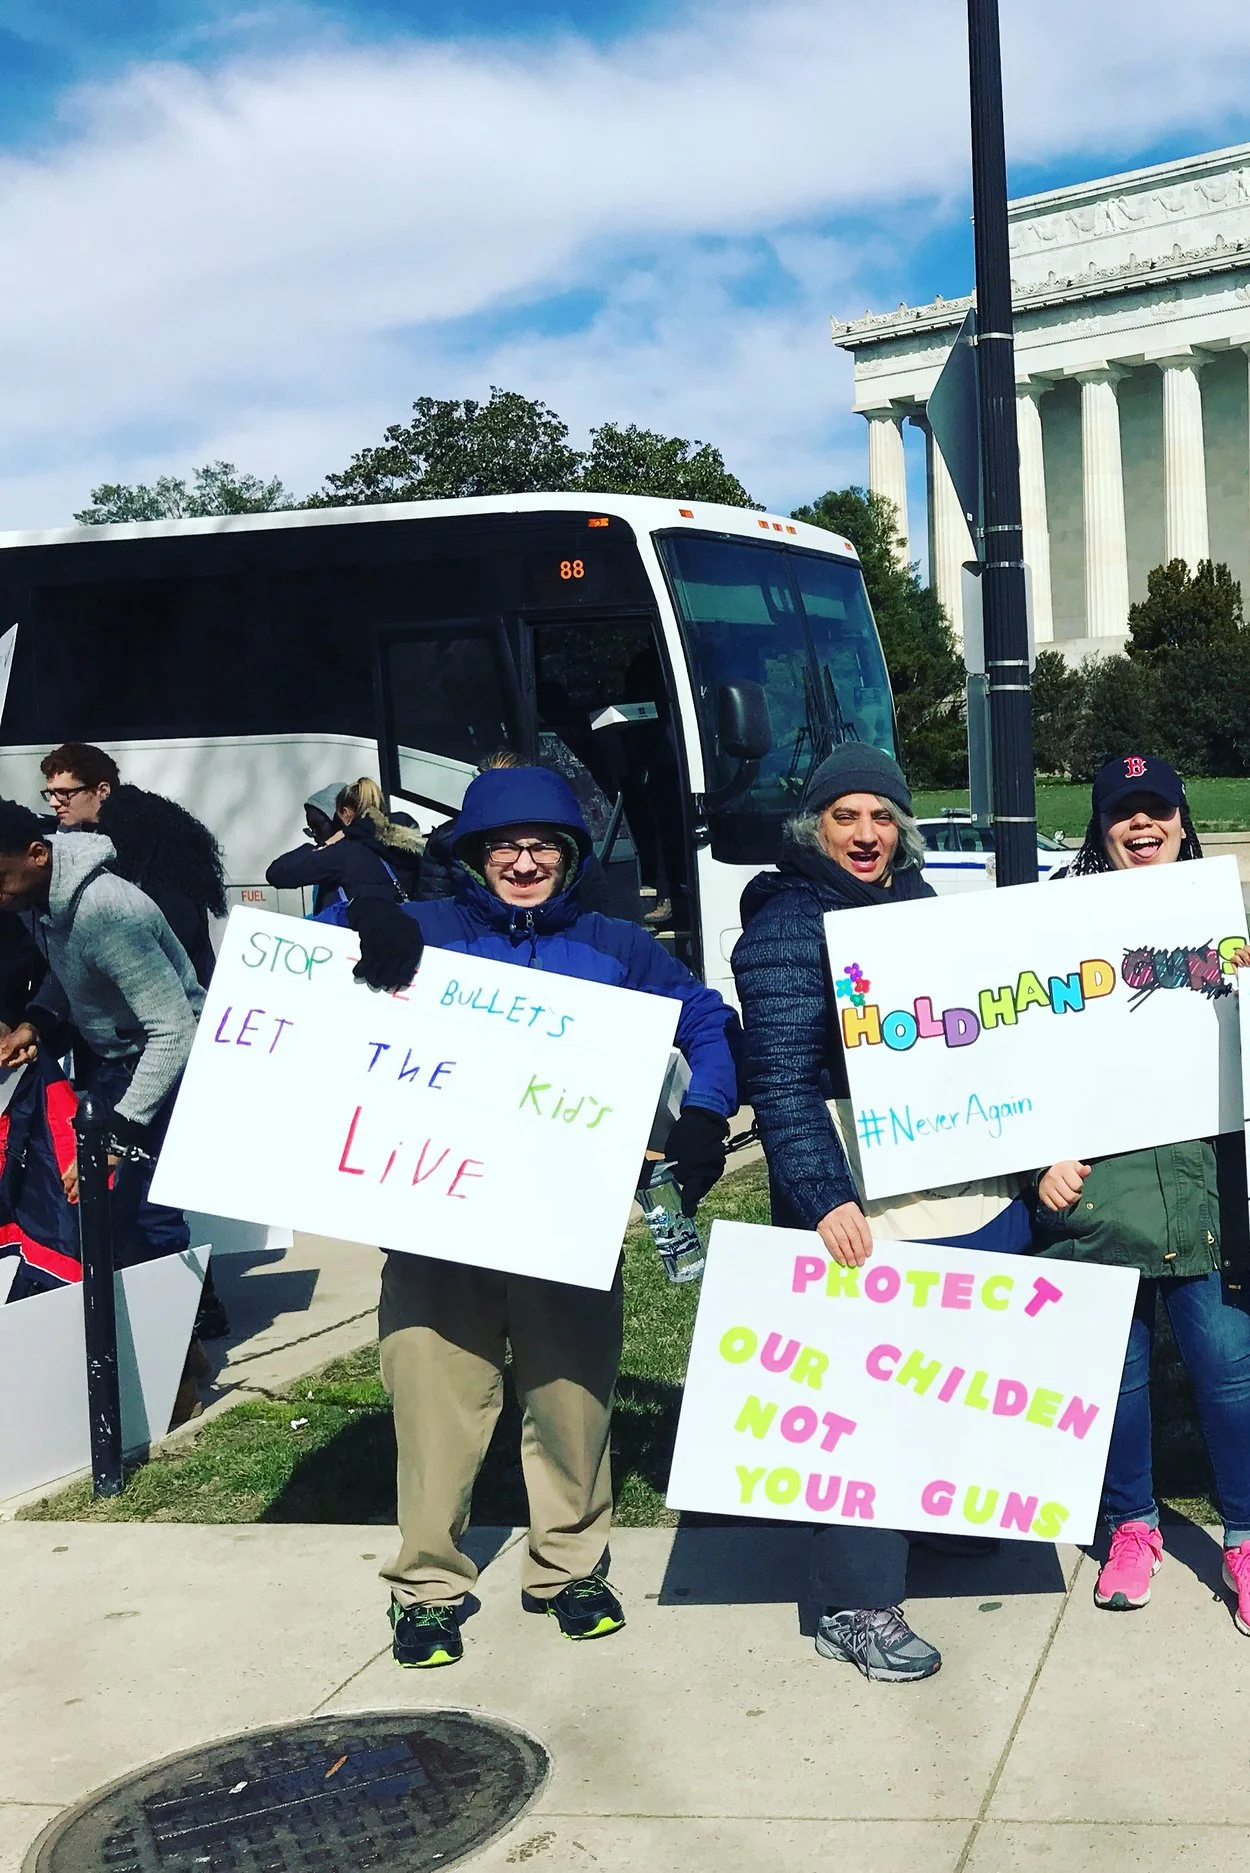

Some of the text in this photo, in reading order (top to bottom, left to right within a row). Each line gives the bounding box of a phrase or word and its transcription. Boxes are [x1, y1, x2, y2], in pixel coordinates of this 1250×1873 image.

[559, 560, 585, 580] 88
[1123, 755, 1148, 779] B
[241, 890, 267, 902] FUEL
[241, 931, 333, 980] STOP
[214, 1006, 294, 1053] LET
[791, 1255, 1064, 1318] PROTECT
[719, 1325, 1100, 1440] OUR CHILDEN
[734, 1395, 857, 1453] NOT
[735, 1465, 1070, 1538] YOUR GUNS
